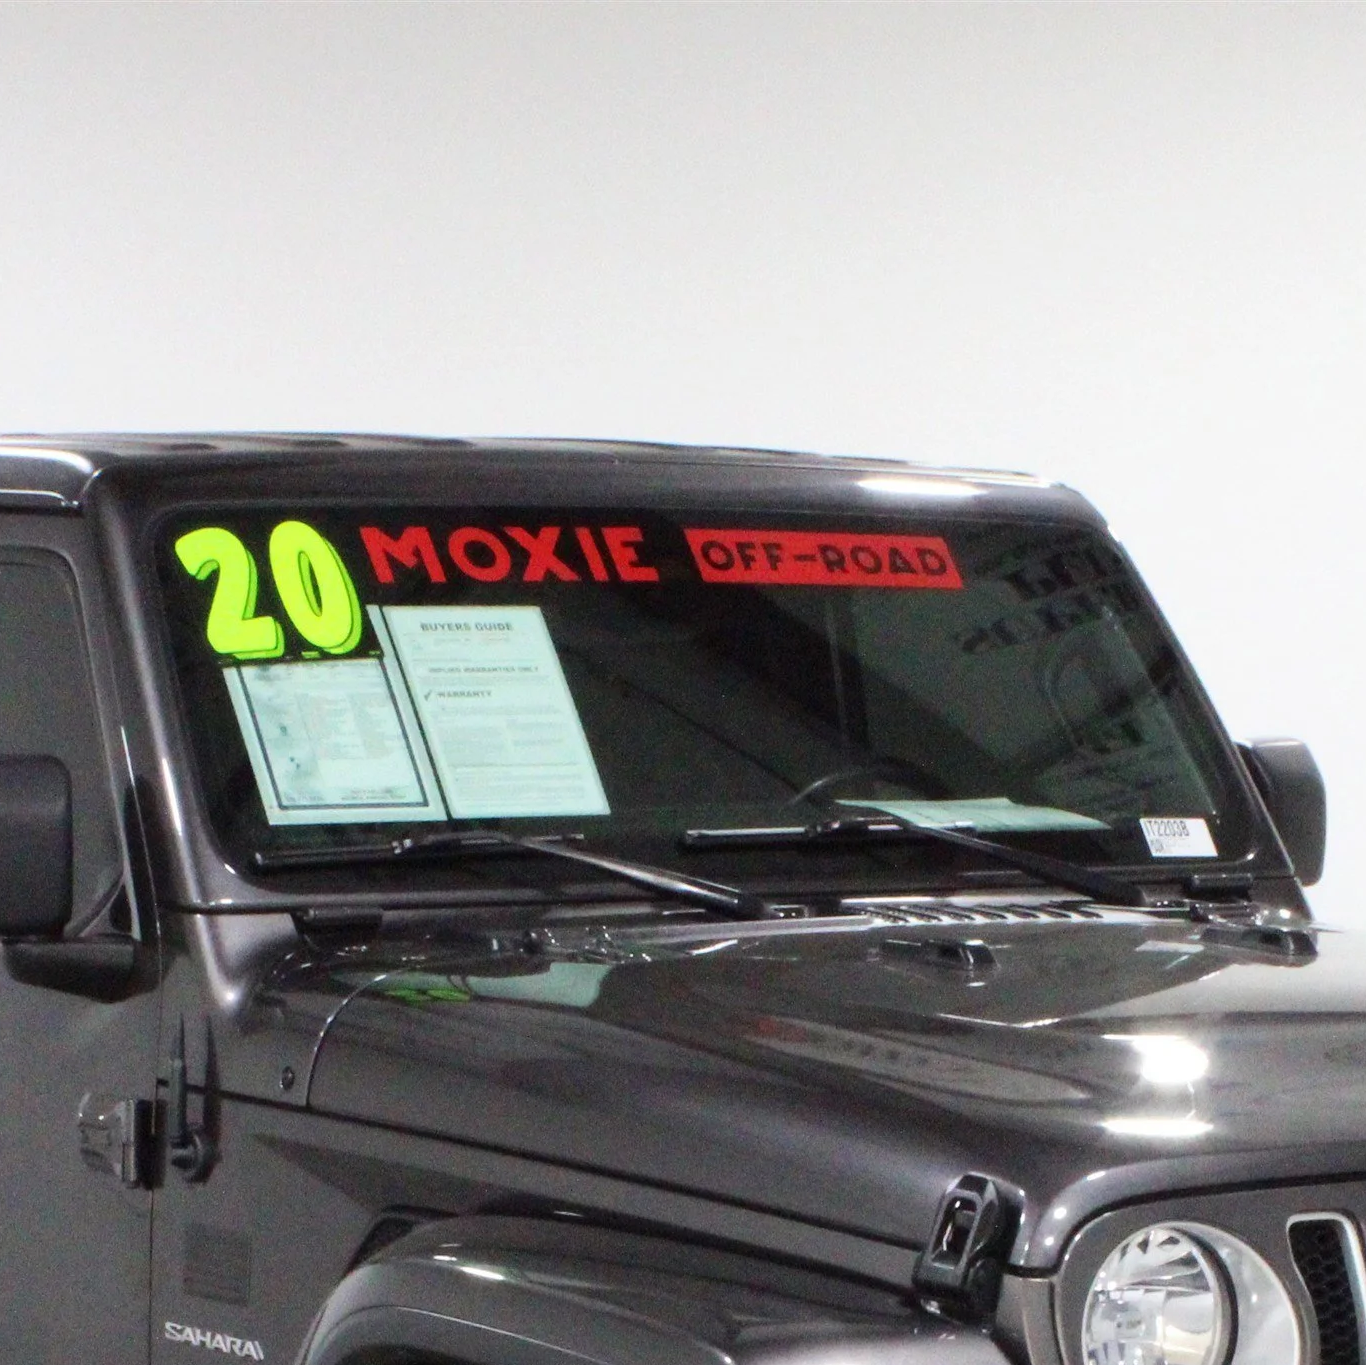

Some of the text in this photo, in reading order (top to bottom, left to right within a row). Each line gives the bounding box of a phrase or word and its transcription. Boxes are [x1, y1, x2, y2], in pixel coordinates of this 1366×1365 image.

[359, 526, 948, 584] MOXIE OFF-ROAD
[175, 520, 362, 660] 20
[420, 621, 514, 632] BUYERS GUIDE
[436, 689, 493, 699] WARRANTY
[164, 1321, 265, 1361] SAHARA
